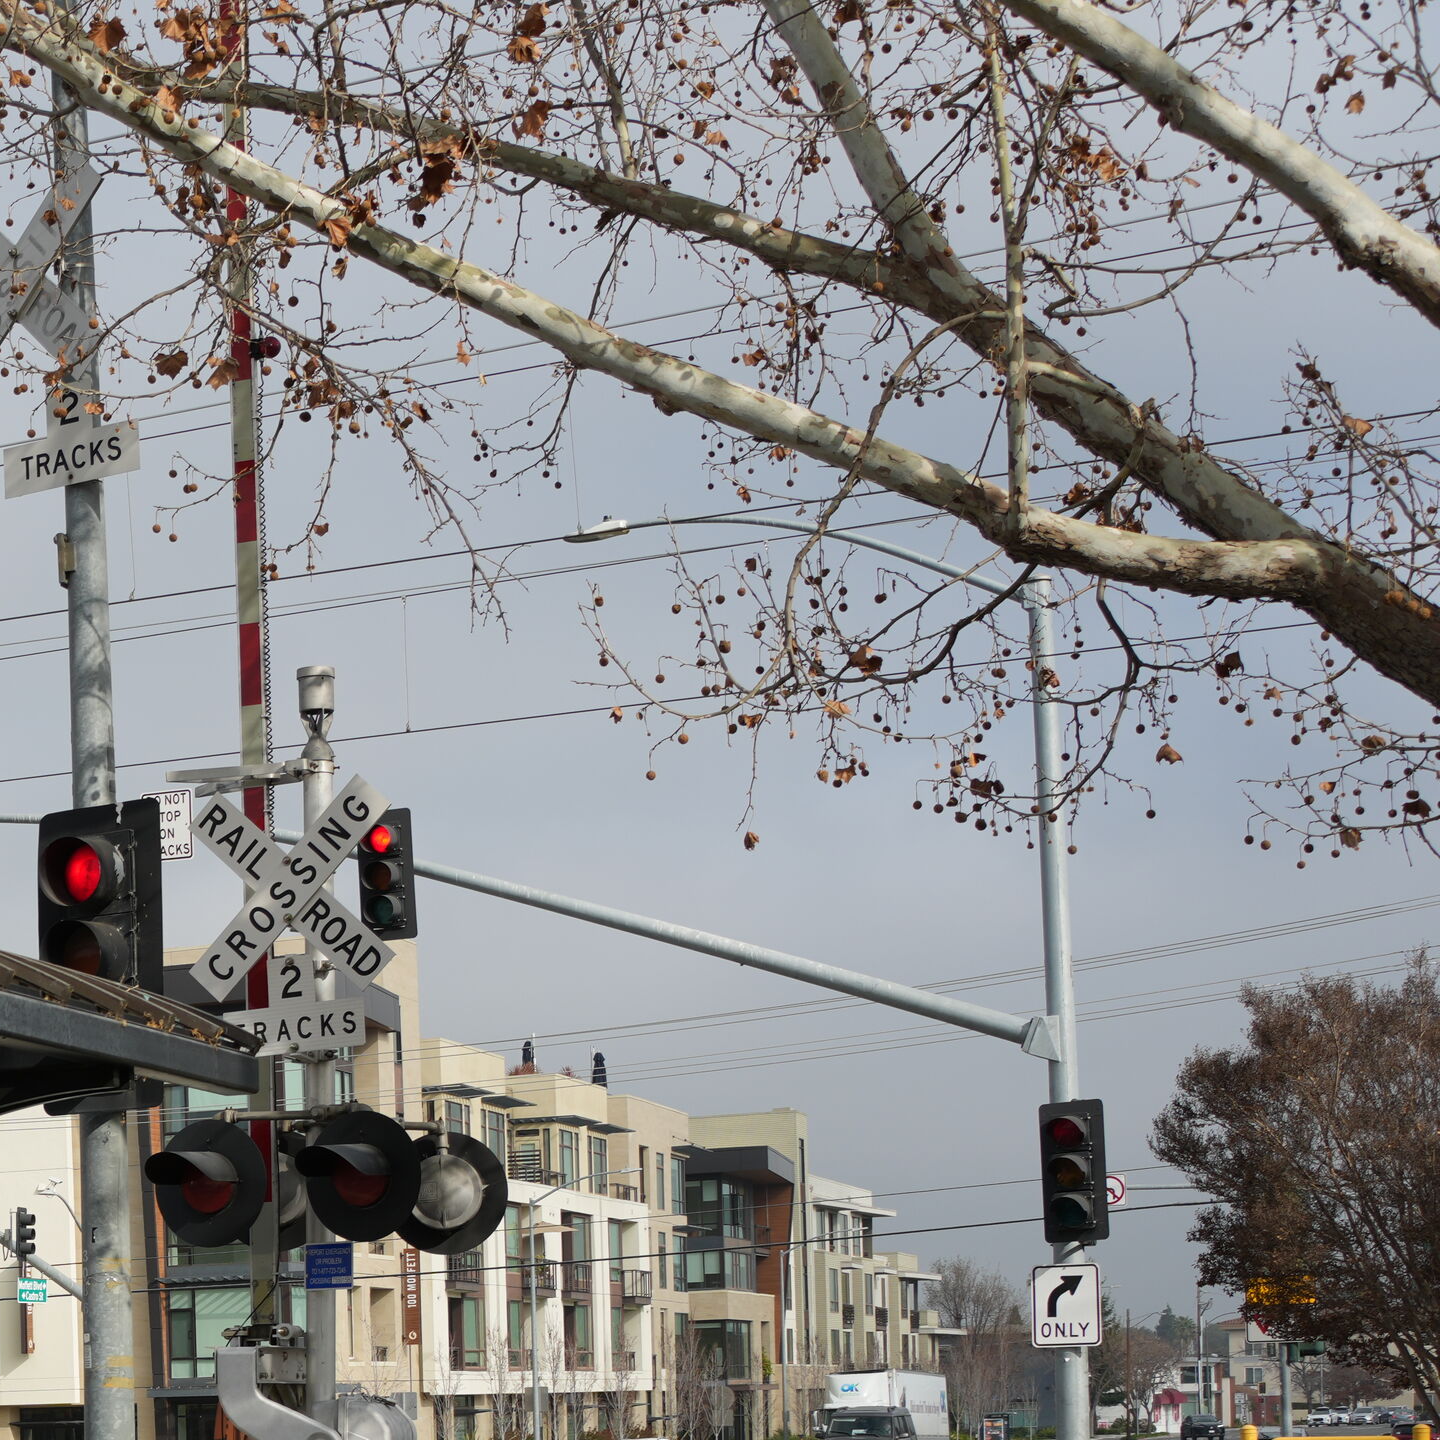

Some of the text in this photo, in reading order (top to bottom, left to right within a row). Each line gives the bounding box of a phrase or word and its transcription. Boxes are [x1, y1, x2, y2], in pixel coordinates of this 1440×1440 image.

[60, 391, 80, 426] 2
[21, 436, 123, 481] TRACKS
[160, 810, 181, 823] TOP
[164, 793, 186, 806] NOT
[160, 828, 175, 839] ON
[161, 844, 190, 856] ACKS
[198, 803, 268, 880] RAIL
[208, 795, 370, 981] CROSSING
[300, 898, 382, 978] ROAD
[280, 964, 303, 999] 2
[238, 1010, 357, 1044] RACKS
[407, 1293, 417, 1308] 100
[1041, 1322, 1090, 1338] ONLY
